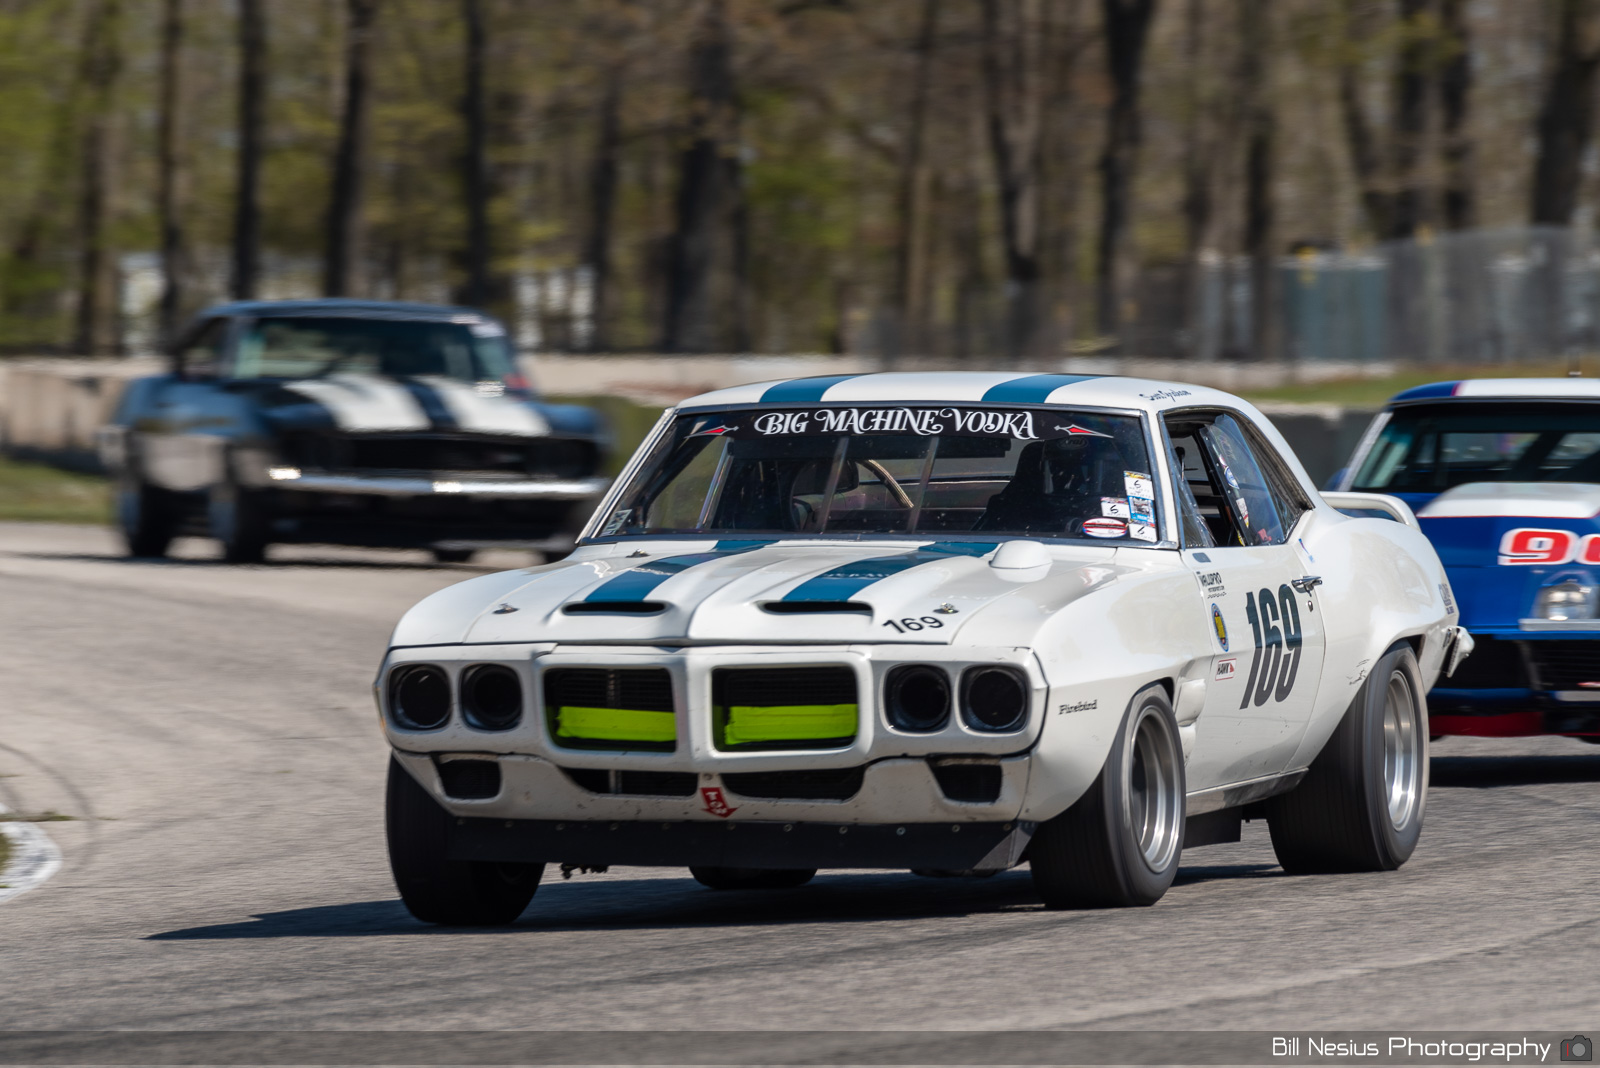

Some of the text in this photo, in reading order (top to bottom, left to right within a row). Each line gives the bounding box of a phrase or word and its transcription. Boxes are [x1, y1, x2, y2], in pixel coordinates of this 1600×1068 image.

[753, 406, 1039, 440] BIG MACHINE VODKA
[882, 616, 944, 634] 169
[1239, 583, 1302, 710] 169
